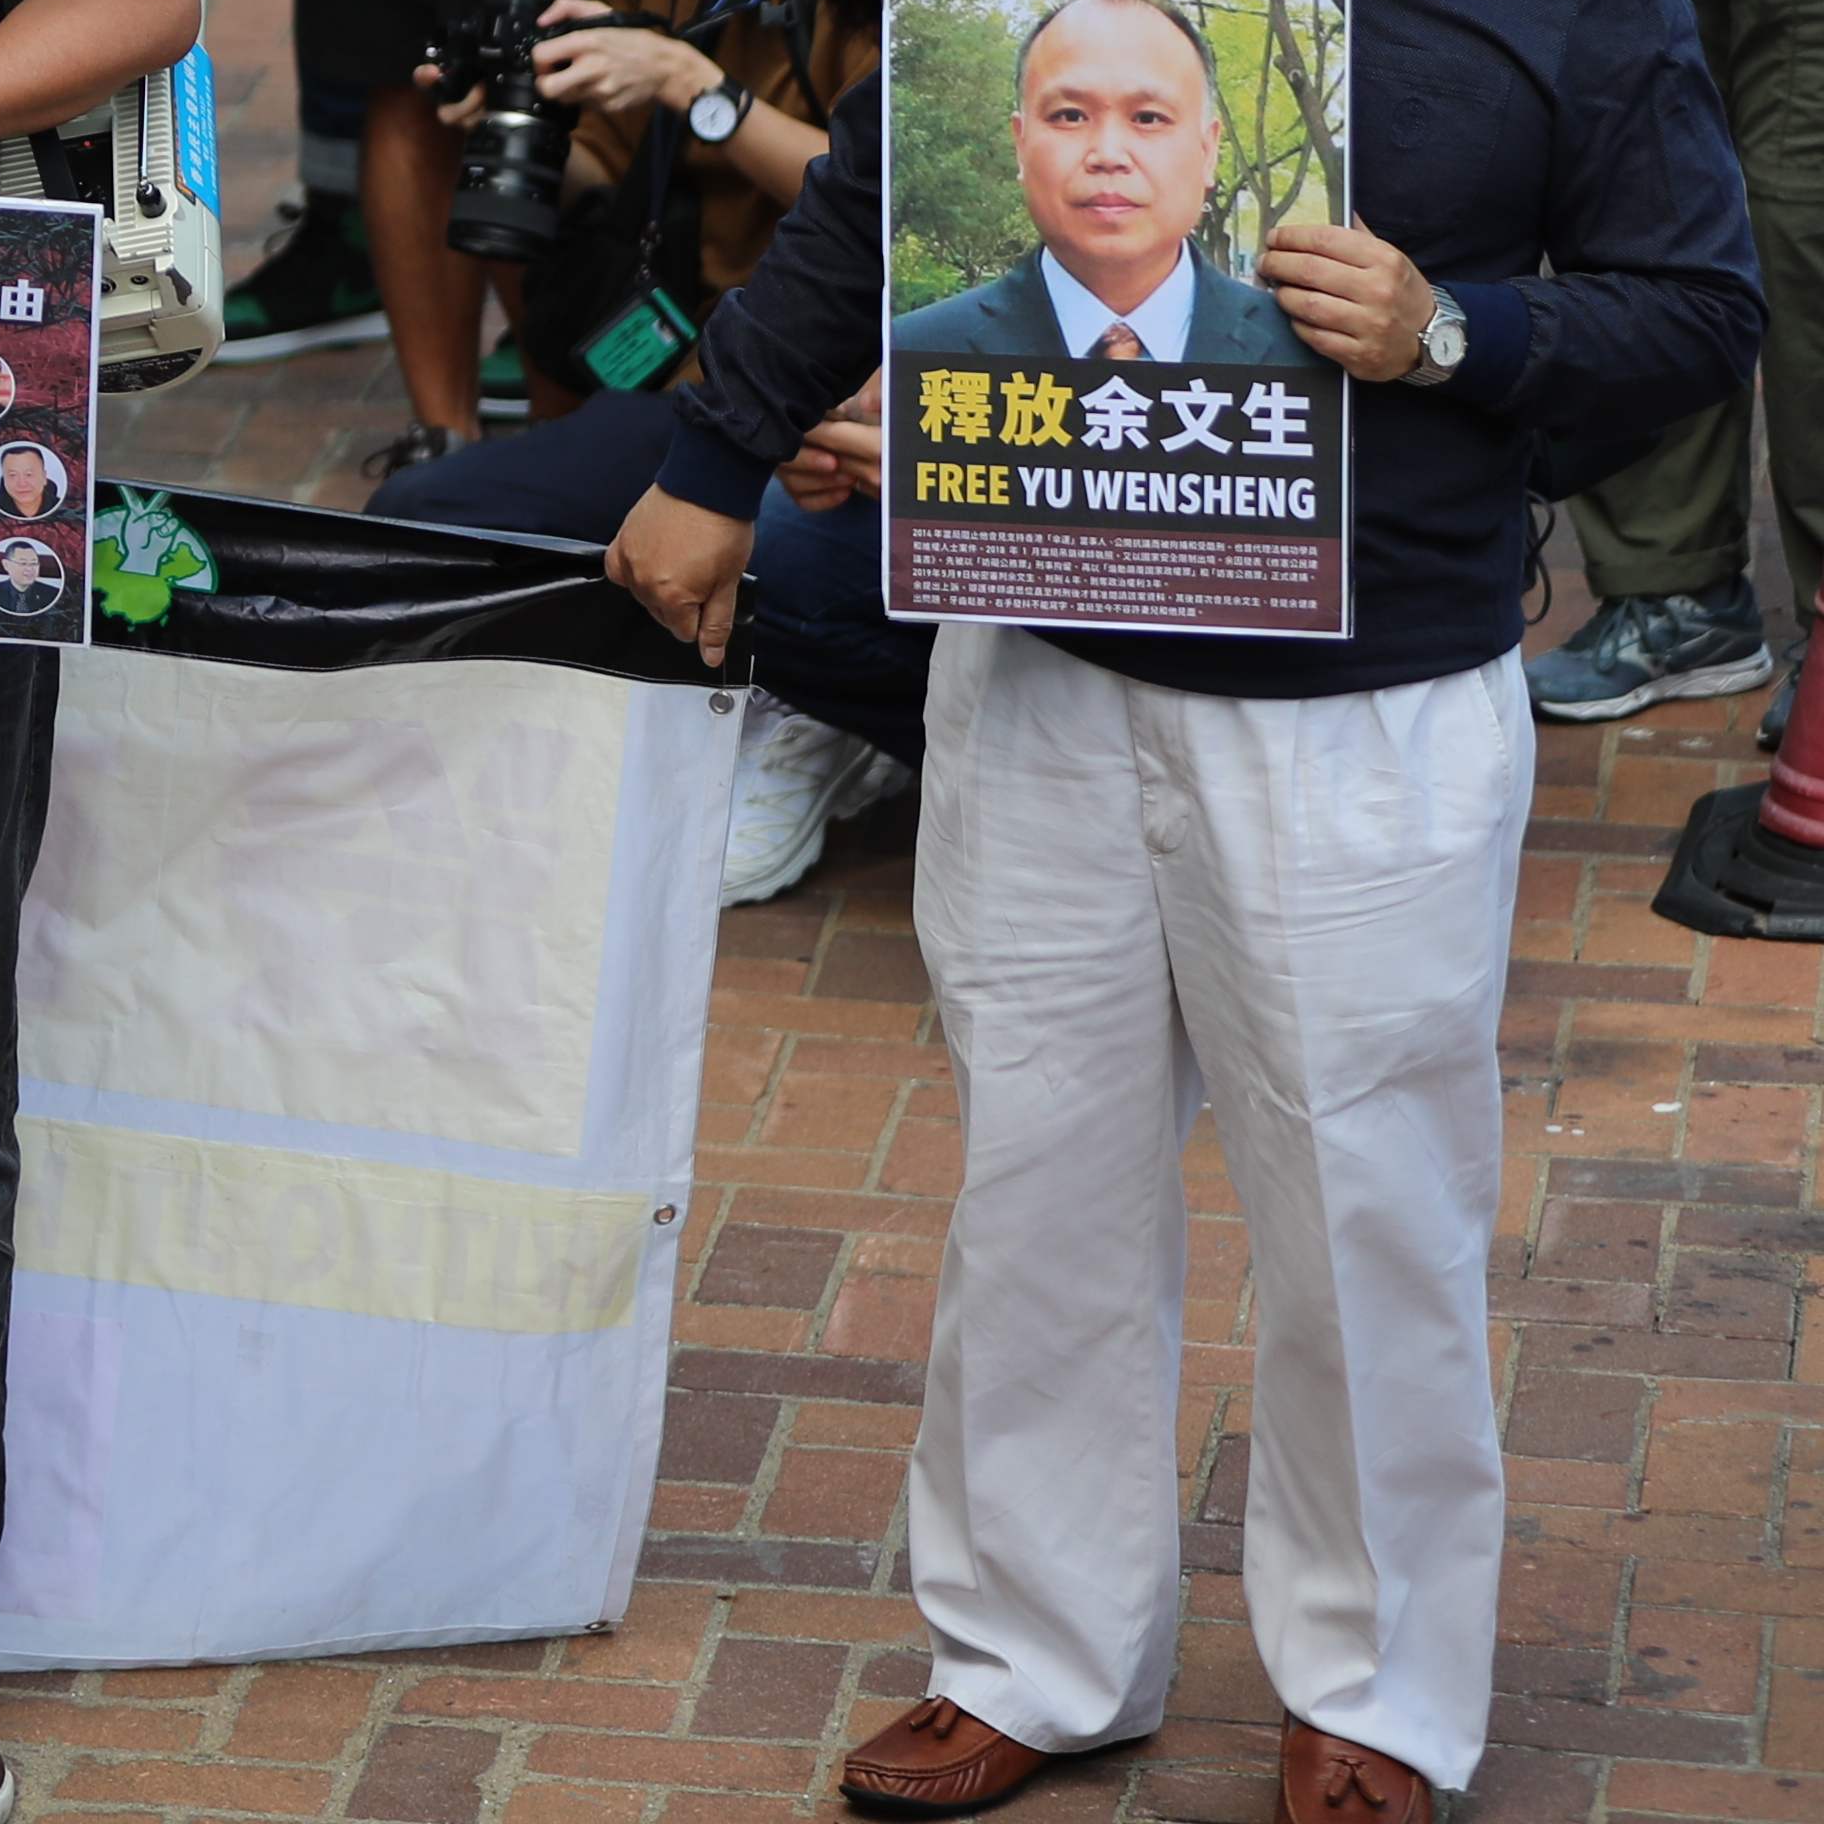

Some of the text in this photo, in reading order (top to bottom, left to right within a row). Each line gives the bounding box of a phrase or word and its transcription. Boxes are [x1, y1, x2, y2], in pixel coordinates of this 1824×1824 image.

[919, 368, 1315, 458] 釋放余文生
[916, 463, 1316, 519] FREE YU WENSHENG
